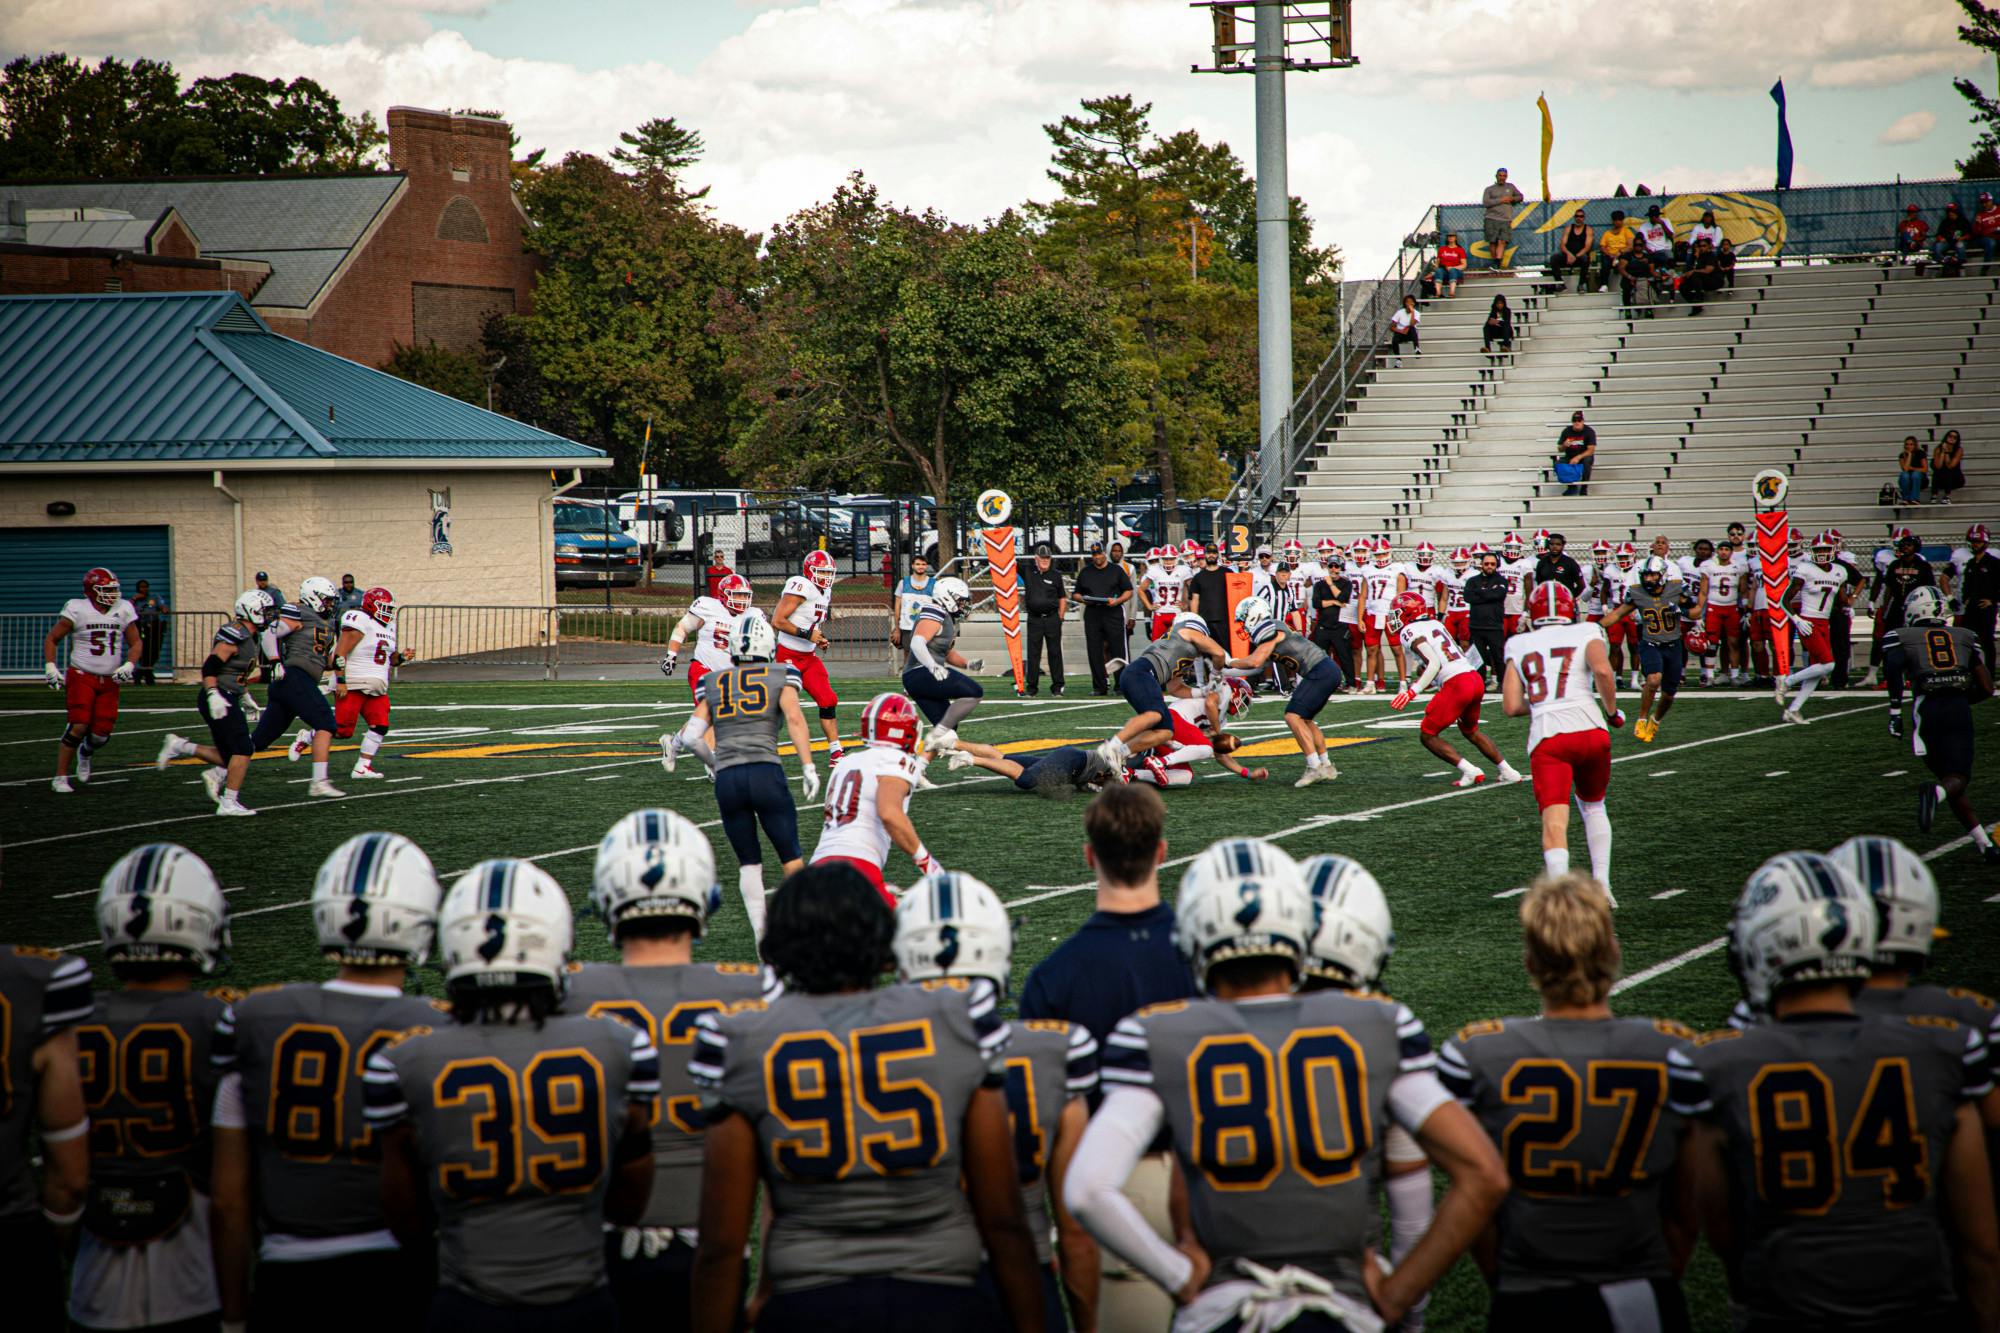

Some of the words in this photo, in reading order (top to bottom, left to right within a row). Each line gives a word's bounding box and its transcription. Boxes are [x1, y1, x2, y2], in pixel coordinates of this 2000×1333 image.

[1230, 525, 1249, 553] 3
[1158, 586, 1180, 606] 93
[1371, 580, 1387, 601] 17
[1719, 577, 1730, 597] 6
[1817, 586, 1834, 612] 7
[1643, 606, 1678, 635] 30
[89, 630, 117, 657] 51
[1924, 628, 1958, 671] 8
[716, 666, 769, 719] 15
[1520, 646, 1578, 706] 87
[1927, 675, 1967, 683] XENITH
[763, 1018, 950, 1180] 95
[1187, 1026, 1373, 1191] 80
[433, 1046, 608, 1198] 39
[1501, 1058, 1671, 1198] 27
[1748, 1056, 1933, 1217] 84
